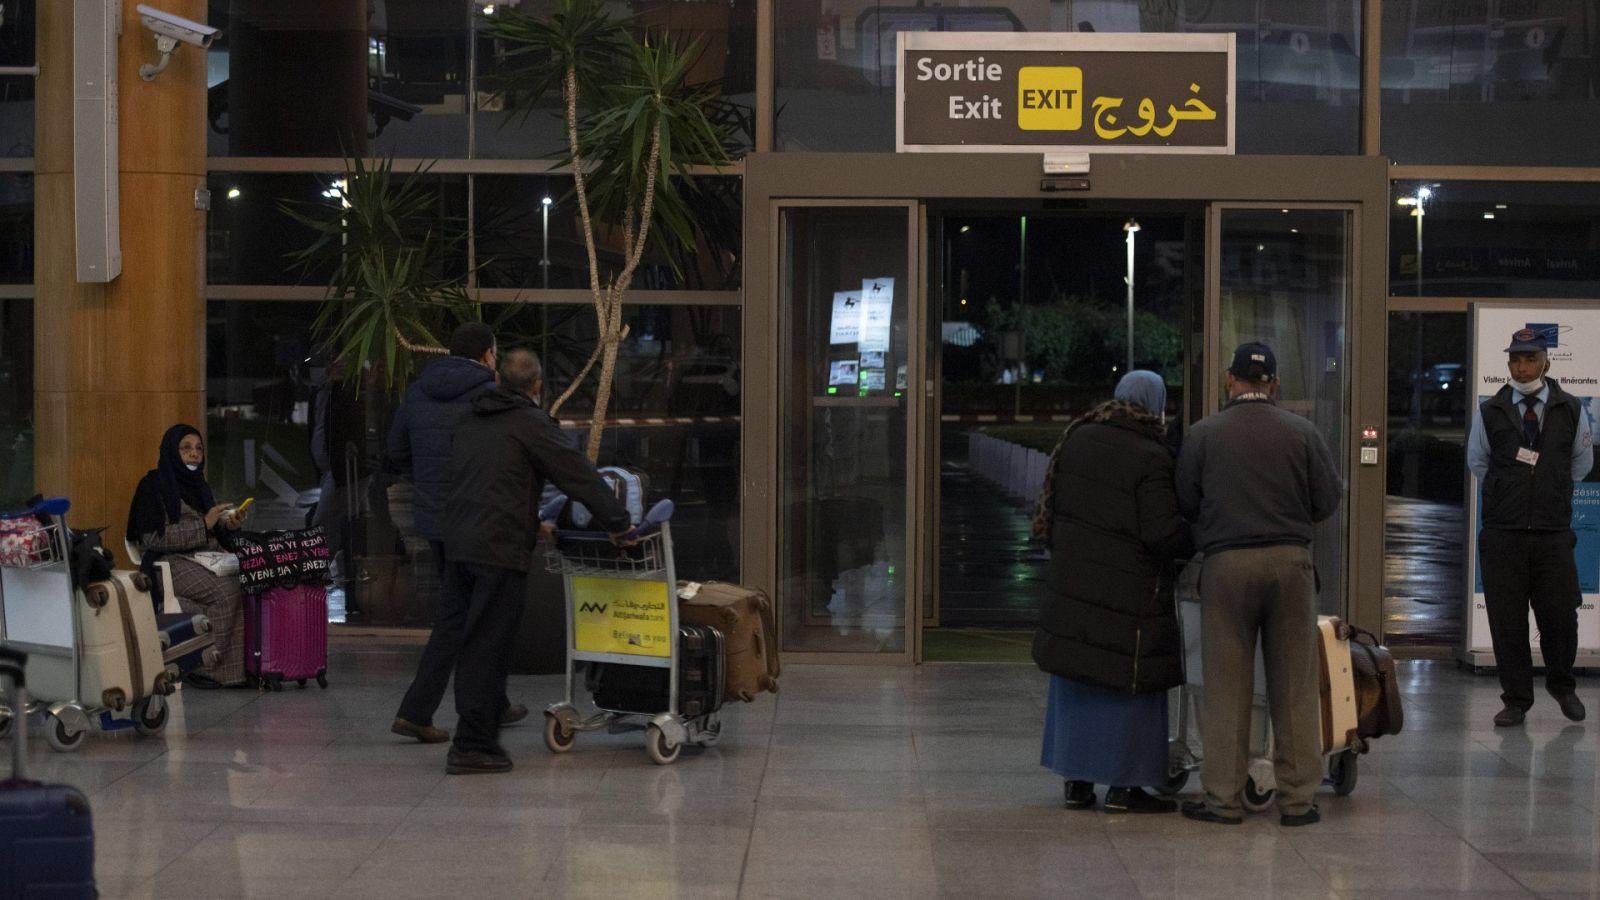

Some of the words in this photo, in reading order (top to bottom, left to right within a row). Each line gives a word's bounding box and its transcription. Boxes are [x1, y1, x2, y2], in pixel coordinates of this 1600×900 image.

[917, 57, 1002, 81] Sortie
[949, 95, 1002, 119] Exit
[1023, 89, 1077, 109] EXIT
[1092, 82, 1217, 140] خروج
[1483, 376, 1505, 384] Visitez
